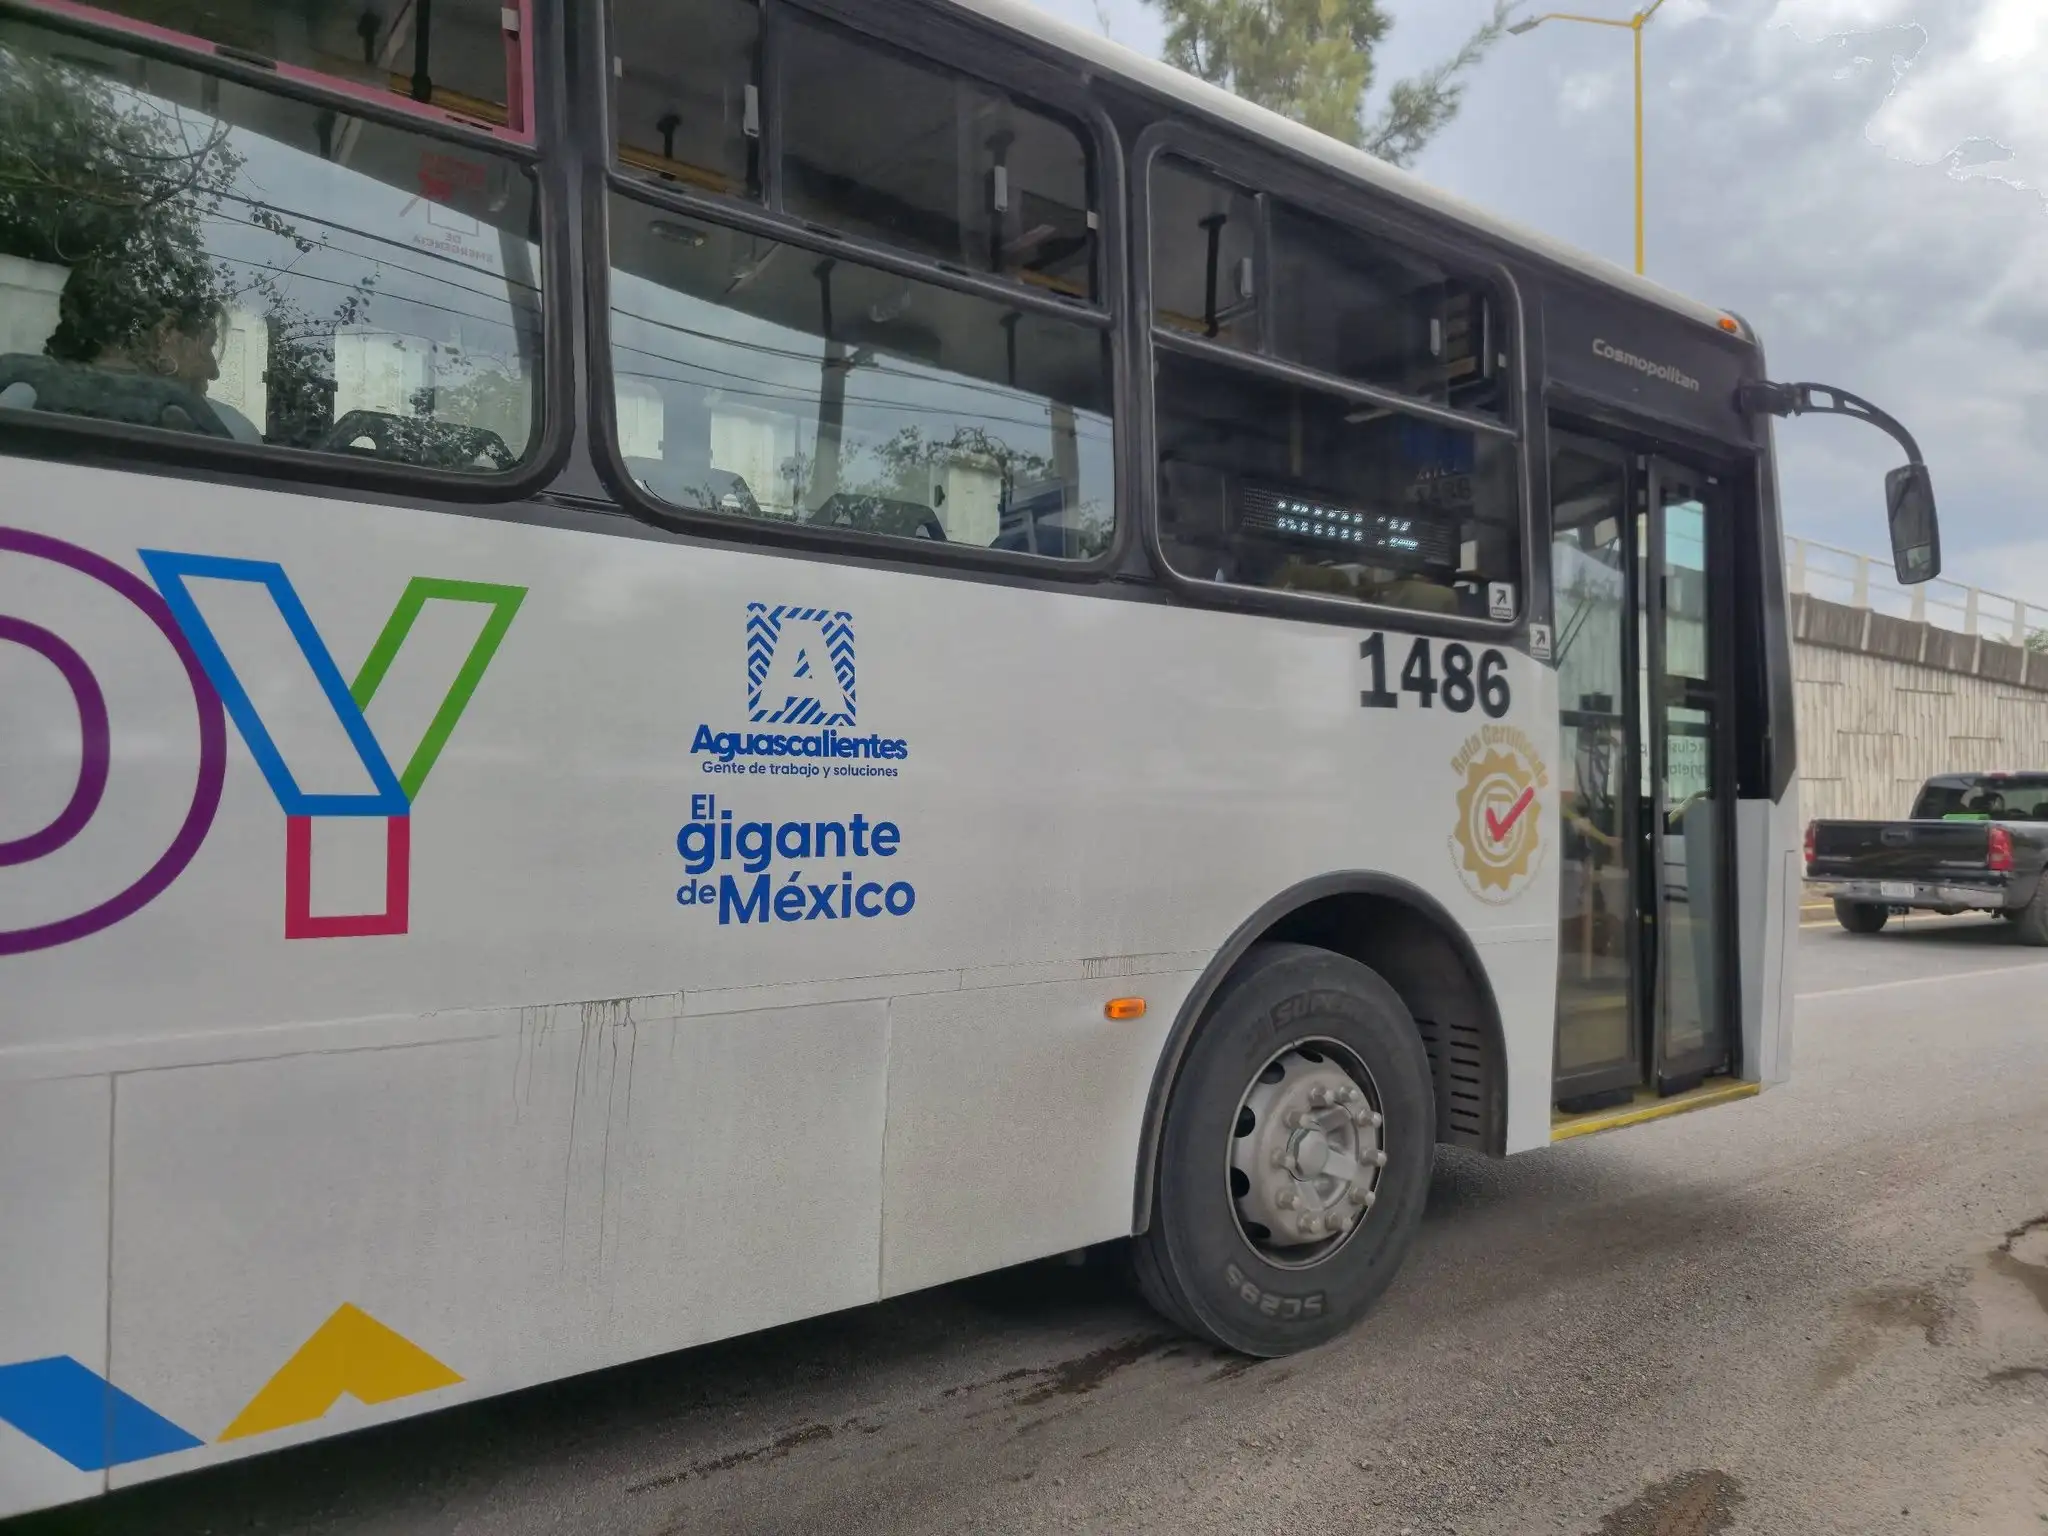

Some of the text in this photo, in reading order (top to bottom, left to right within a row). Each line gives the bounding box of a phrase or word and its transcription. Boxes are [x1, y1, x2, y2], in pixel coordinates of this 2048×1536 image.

[1592, 338, 1699, 391] Cosmopolitan
[1360, 631, 1511, 718] 1486
[690, 724, 908, 762] Aguascalientes
[702, 761, 898, 779] Gente de trabajo y soluciones
[691, 794, 715, 820] El
[676, 810, 901, 875] gigante
[676, 871, 916, 925] de México
